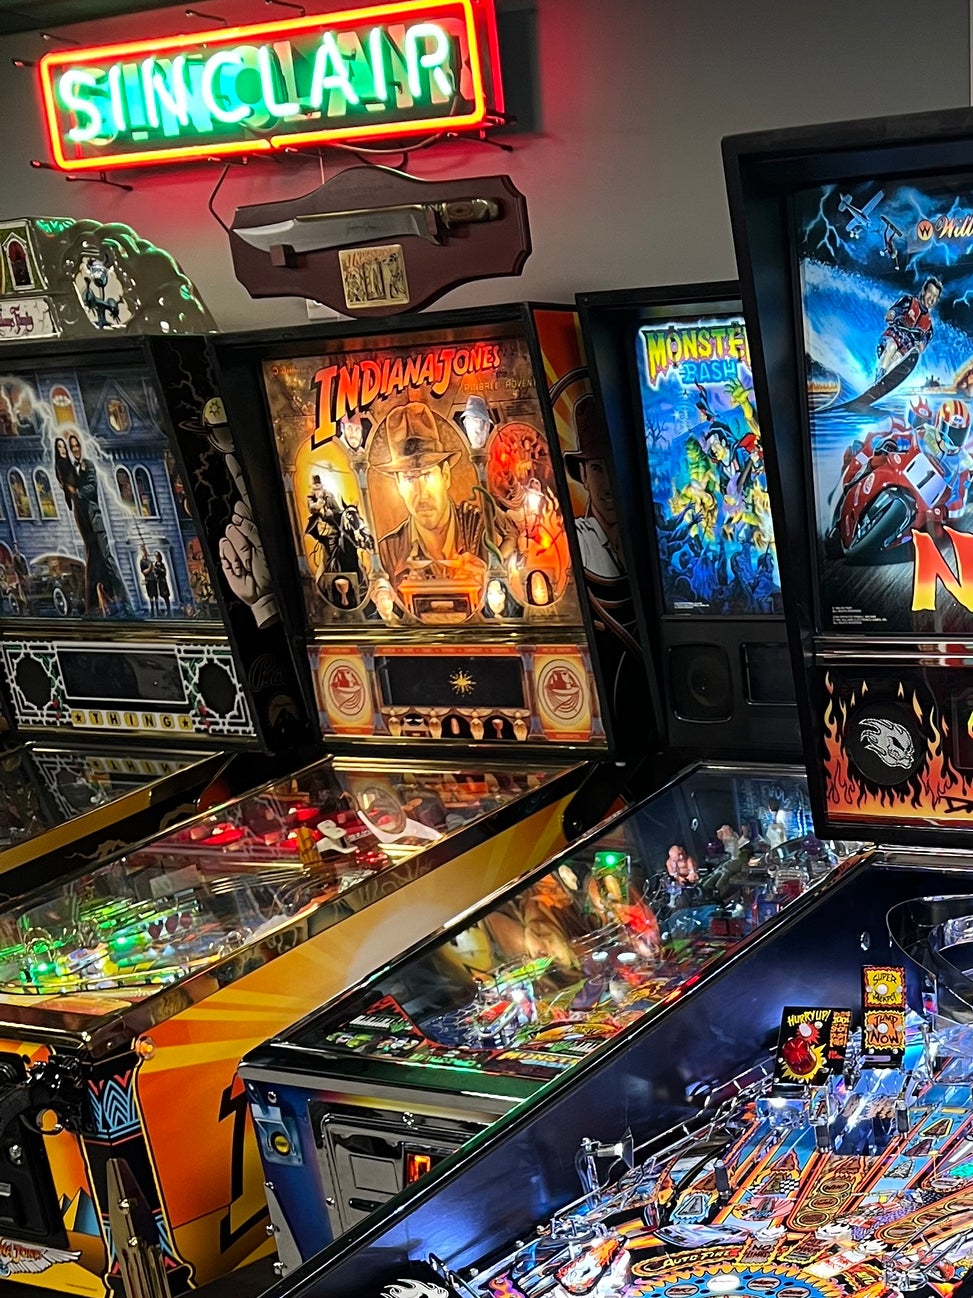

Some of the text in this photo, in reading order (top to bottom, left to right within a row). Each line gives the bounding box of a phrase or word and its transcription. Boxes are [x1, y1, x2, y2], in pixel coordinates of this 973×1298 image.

[58, 22, 453, 143] SINCLAIR
[681, 359, 738, 384] BASH
[311, 343, 501, 448] INDIANA JONES
[92, 712, 174, 728] THING
[873, 972, 897, 985] SUPER
[787, 1009, 832, 1027] HURRY UP!
[869, 1030, 900, 1043] NOW
[662, 1254, 698, 1268] AUTO
